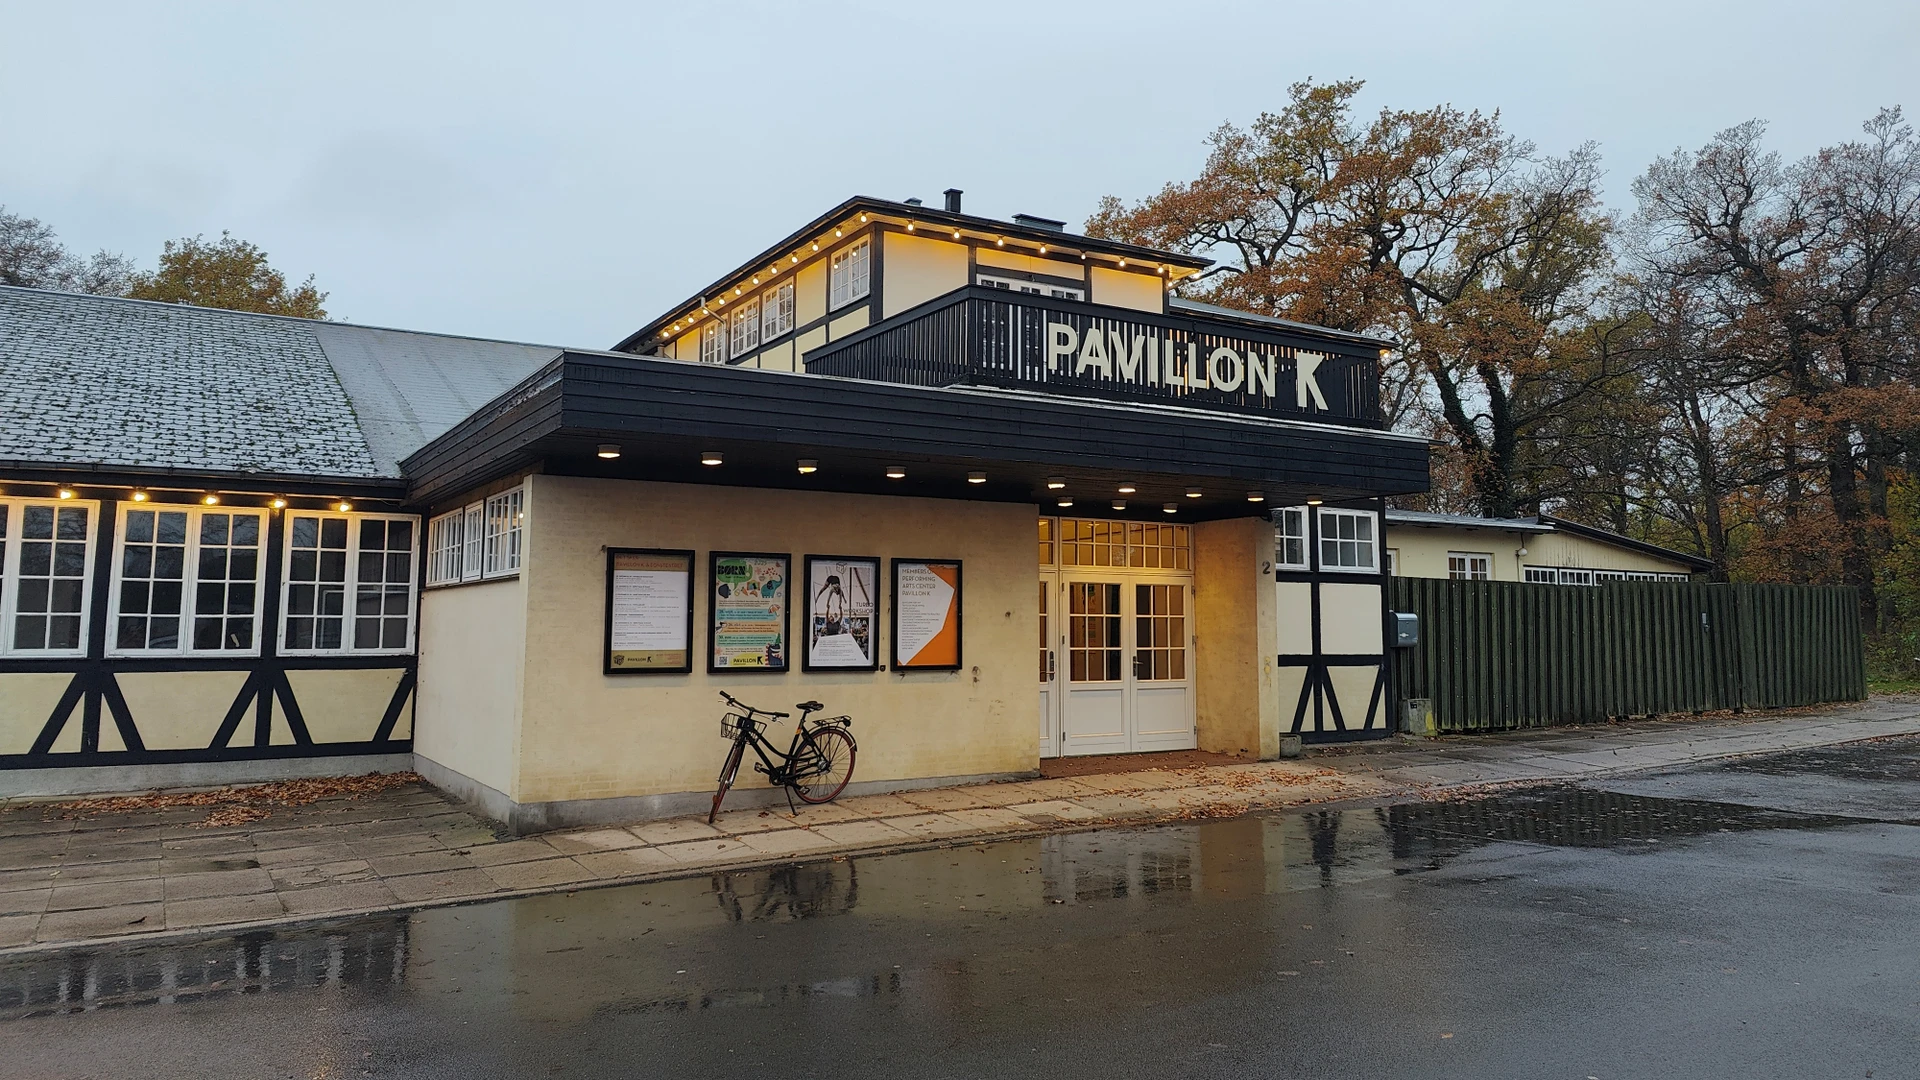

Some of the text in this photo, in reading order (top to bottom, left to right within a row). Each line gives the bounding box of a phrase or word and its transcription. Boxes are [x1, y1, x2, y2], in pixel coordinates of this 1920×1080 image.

[1047, 322, 1329, 411] PAVILLON K
[1262, 560, 1271, 575] 2
[757, 656, 763, 665] K
